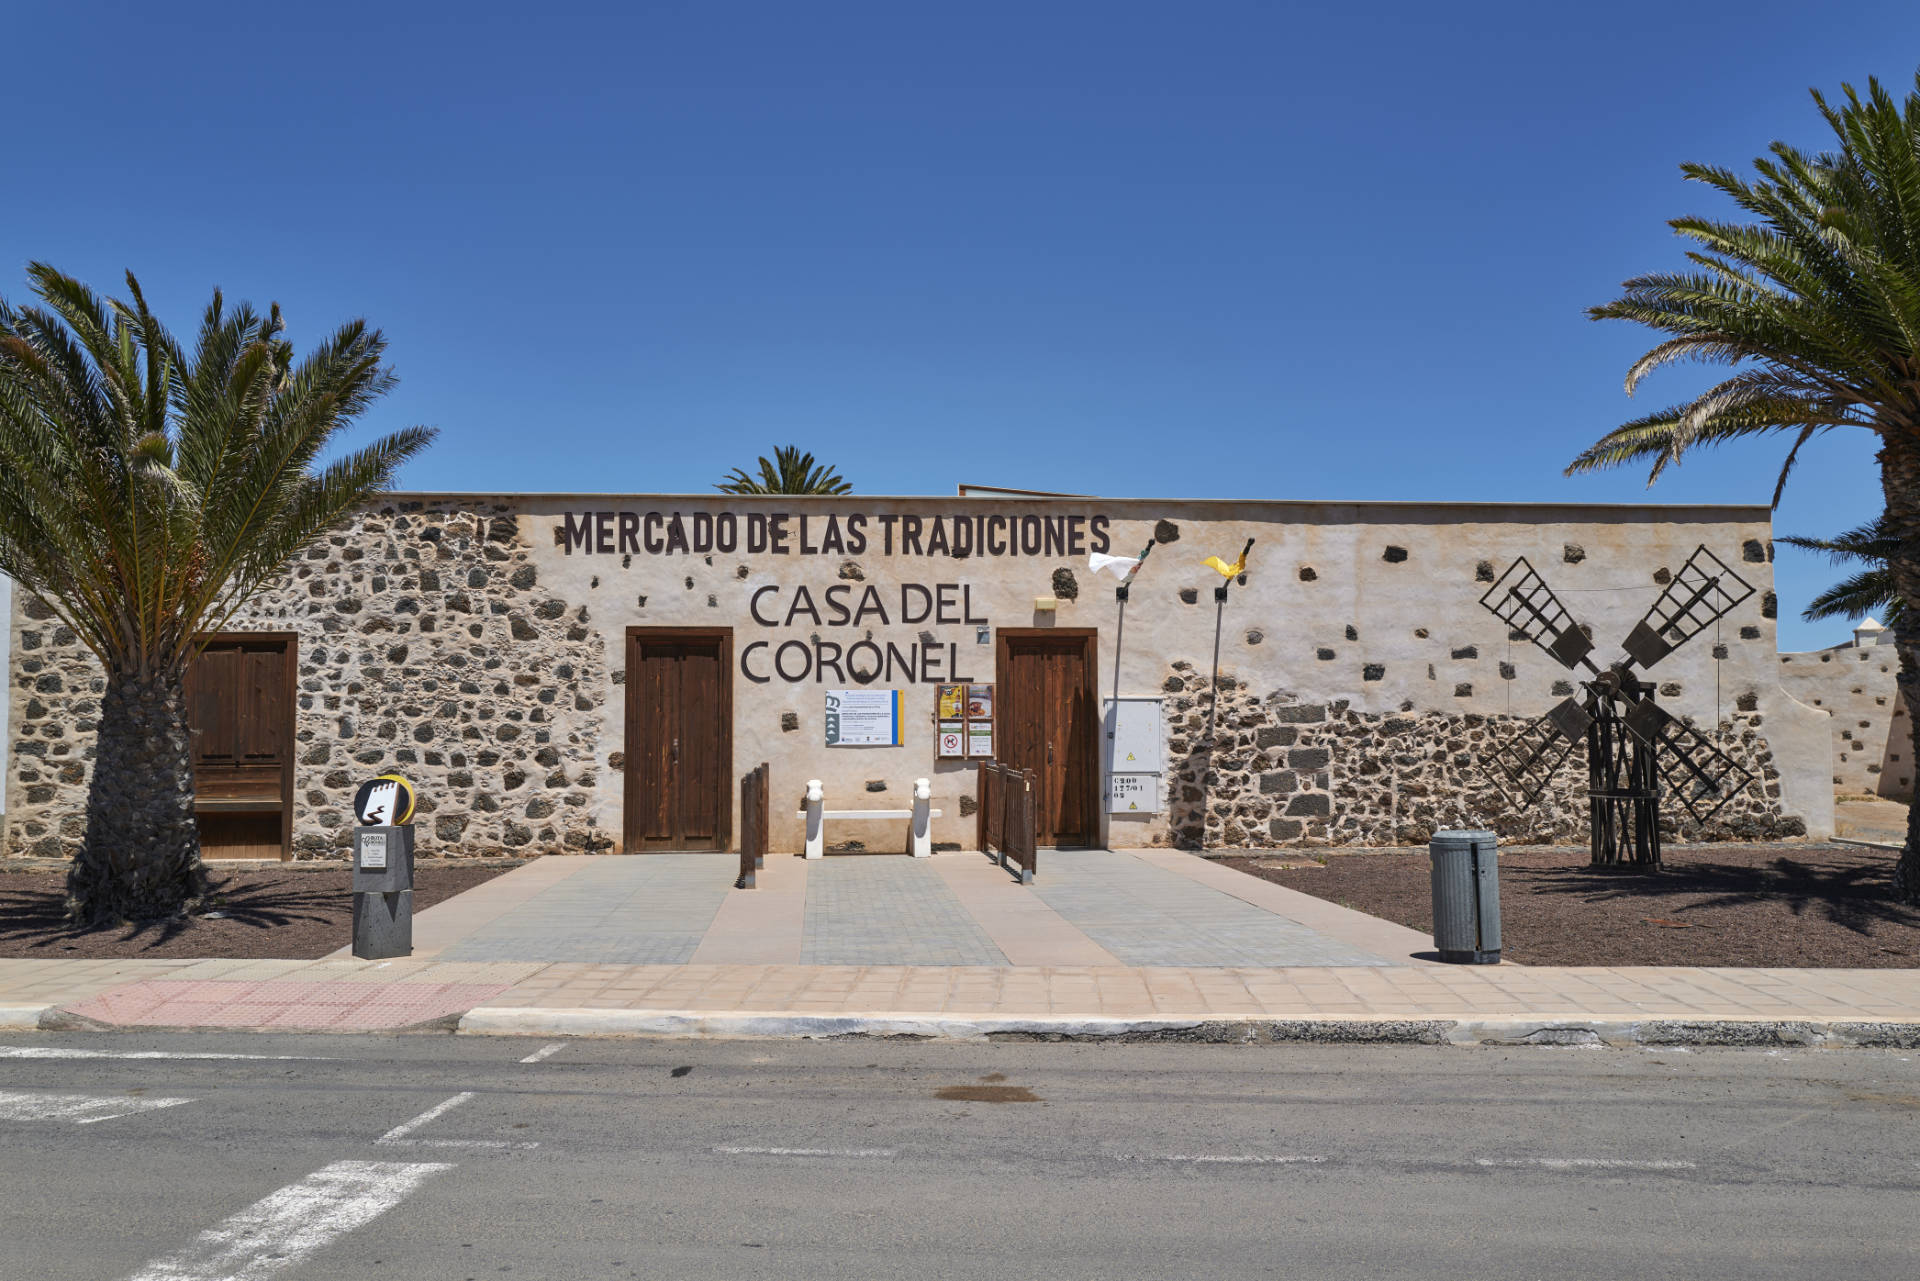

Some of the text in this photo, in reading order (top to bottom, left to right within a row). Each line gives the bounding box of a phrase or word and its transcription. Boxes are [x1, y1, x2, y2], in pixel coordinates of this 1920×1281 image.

[564, 512, 1111, 557] MERCADO DE LAS TRADICIONES
[750, 583, 989, 627] CASA DEL
[740, 640, 974, 685] CORONEL
